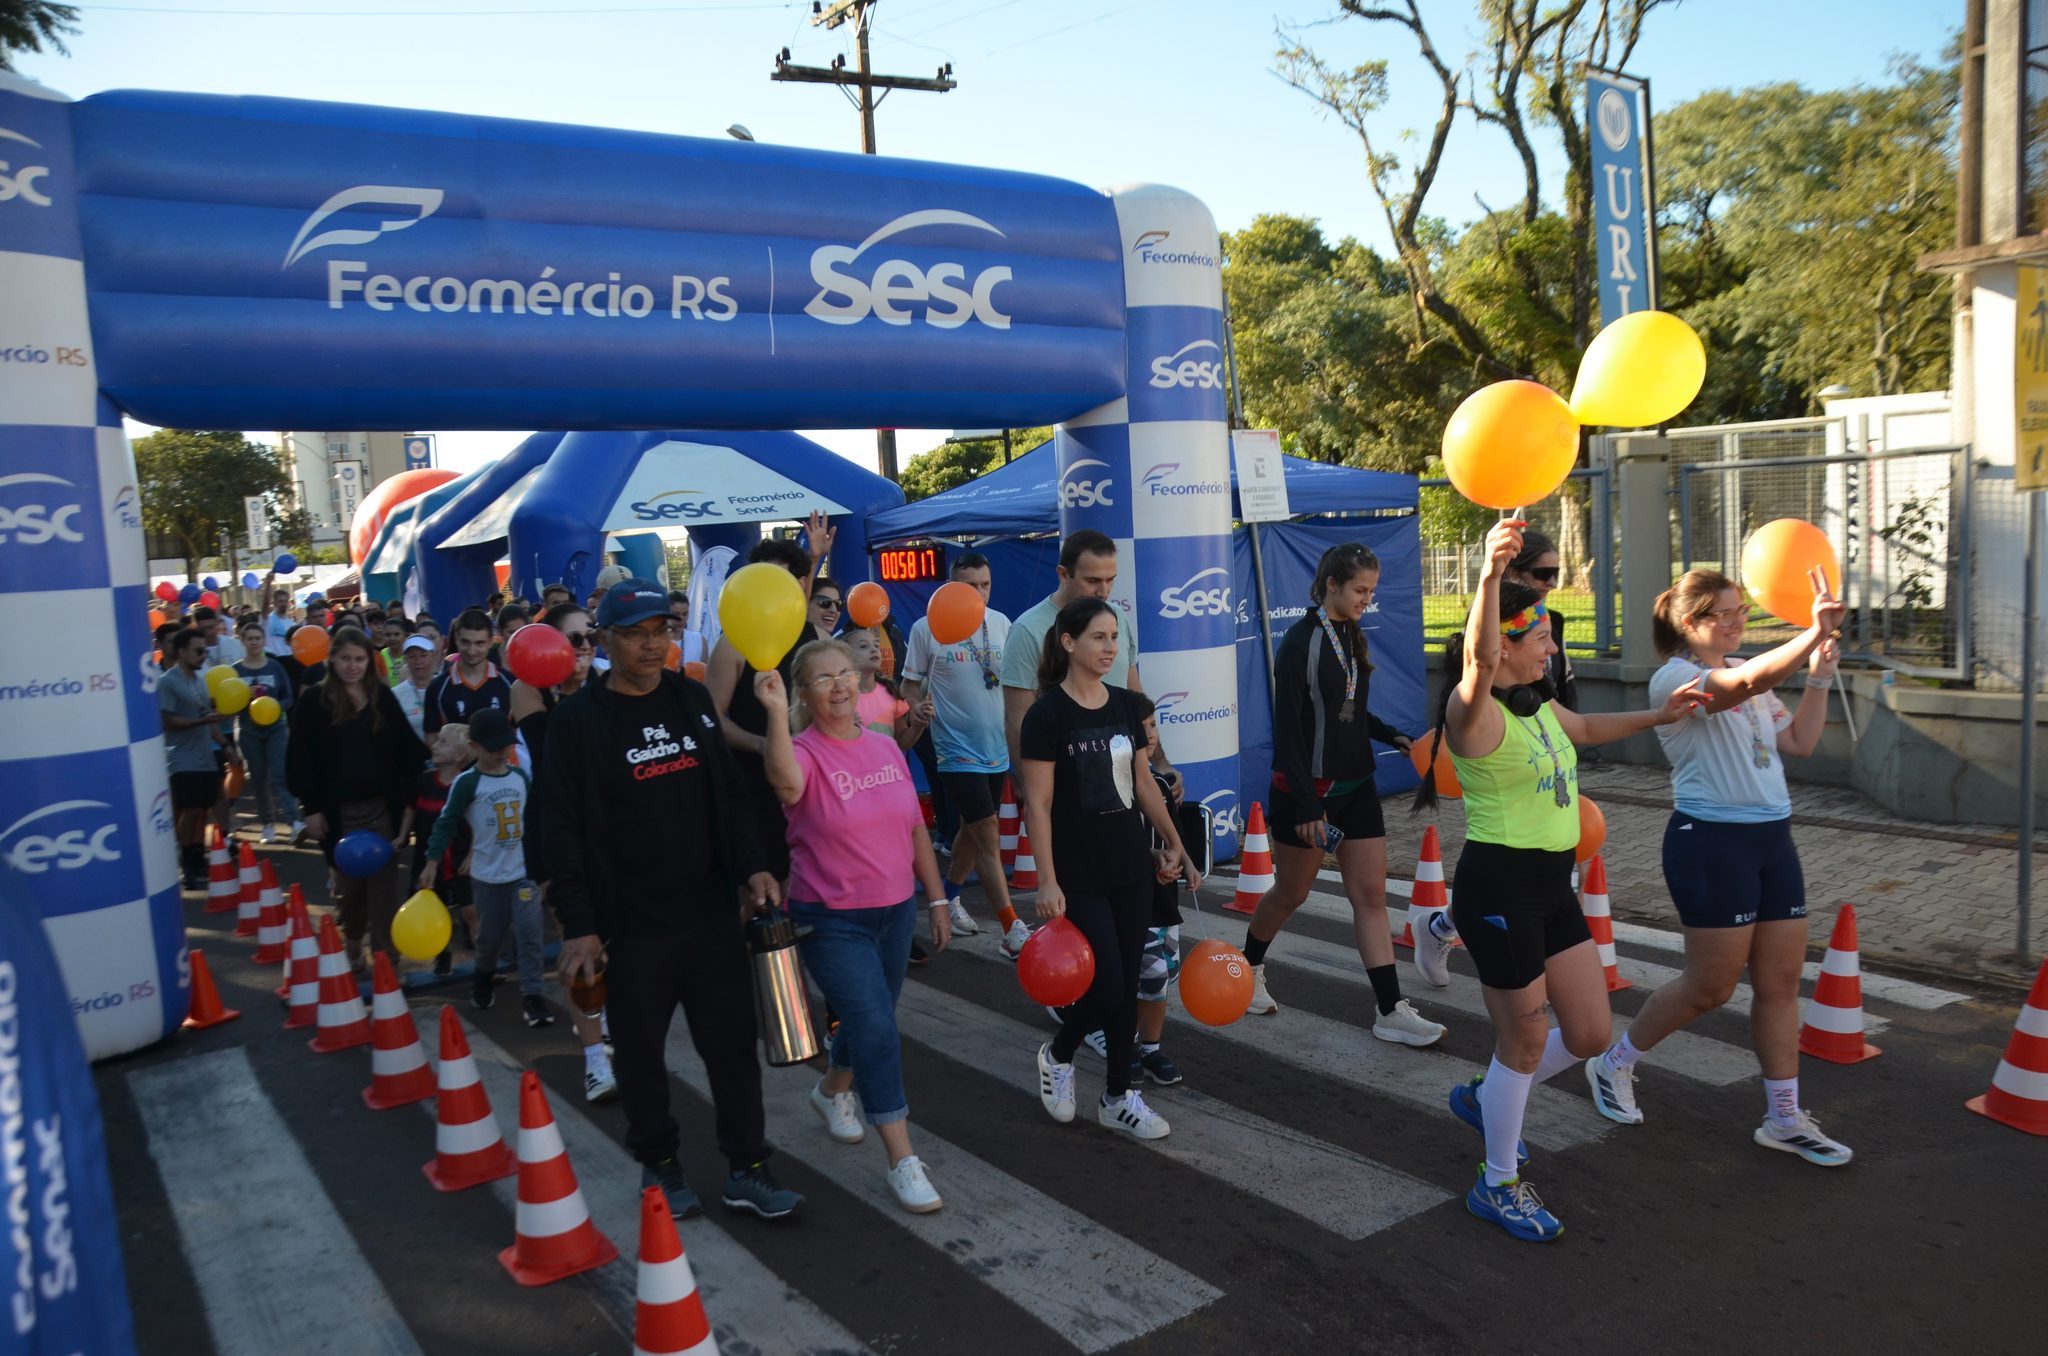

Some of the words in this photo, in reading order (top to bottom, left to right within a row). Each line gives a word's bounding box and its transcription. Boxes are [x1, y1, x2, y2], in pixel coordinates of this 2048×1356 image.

[1142, 250, 1213, 268] Fecomércio
[328, 259, 655, 318] Fecomércio
[671, 274, 738, 321] RS
[804, 243, 1012, 330] Sesc
[56, 346, 87, 367] RS
[1149, 355, 1222, 390] Sesc
[344, 484, 357, 516] UR
[1151, 481, 1222, 496] Fecomércio
[630, 501, 723, 521] Sesc
[728, 490, 805, 505] Fecomércio
[1158, 586, 1232, 619] Sesc
[1259, 606, 1308, 620] ndicatos
[90, 672, 118, 693] RS
[1160, 706, 1230, 725] Fecomércio
[642, 723, 671, 742] Pai,
[626, 740, 681, 764] Gaúcho
[682, 735, 698, 751] &
[633, 754, 700, 780] Colorado.
[492, 799, 522, 841] H
[4, 823, 122, 873] esc
[129, 980, 156, 1002] RS
